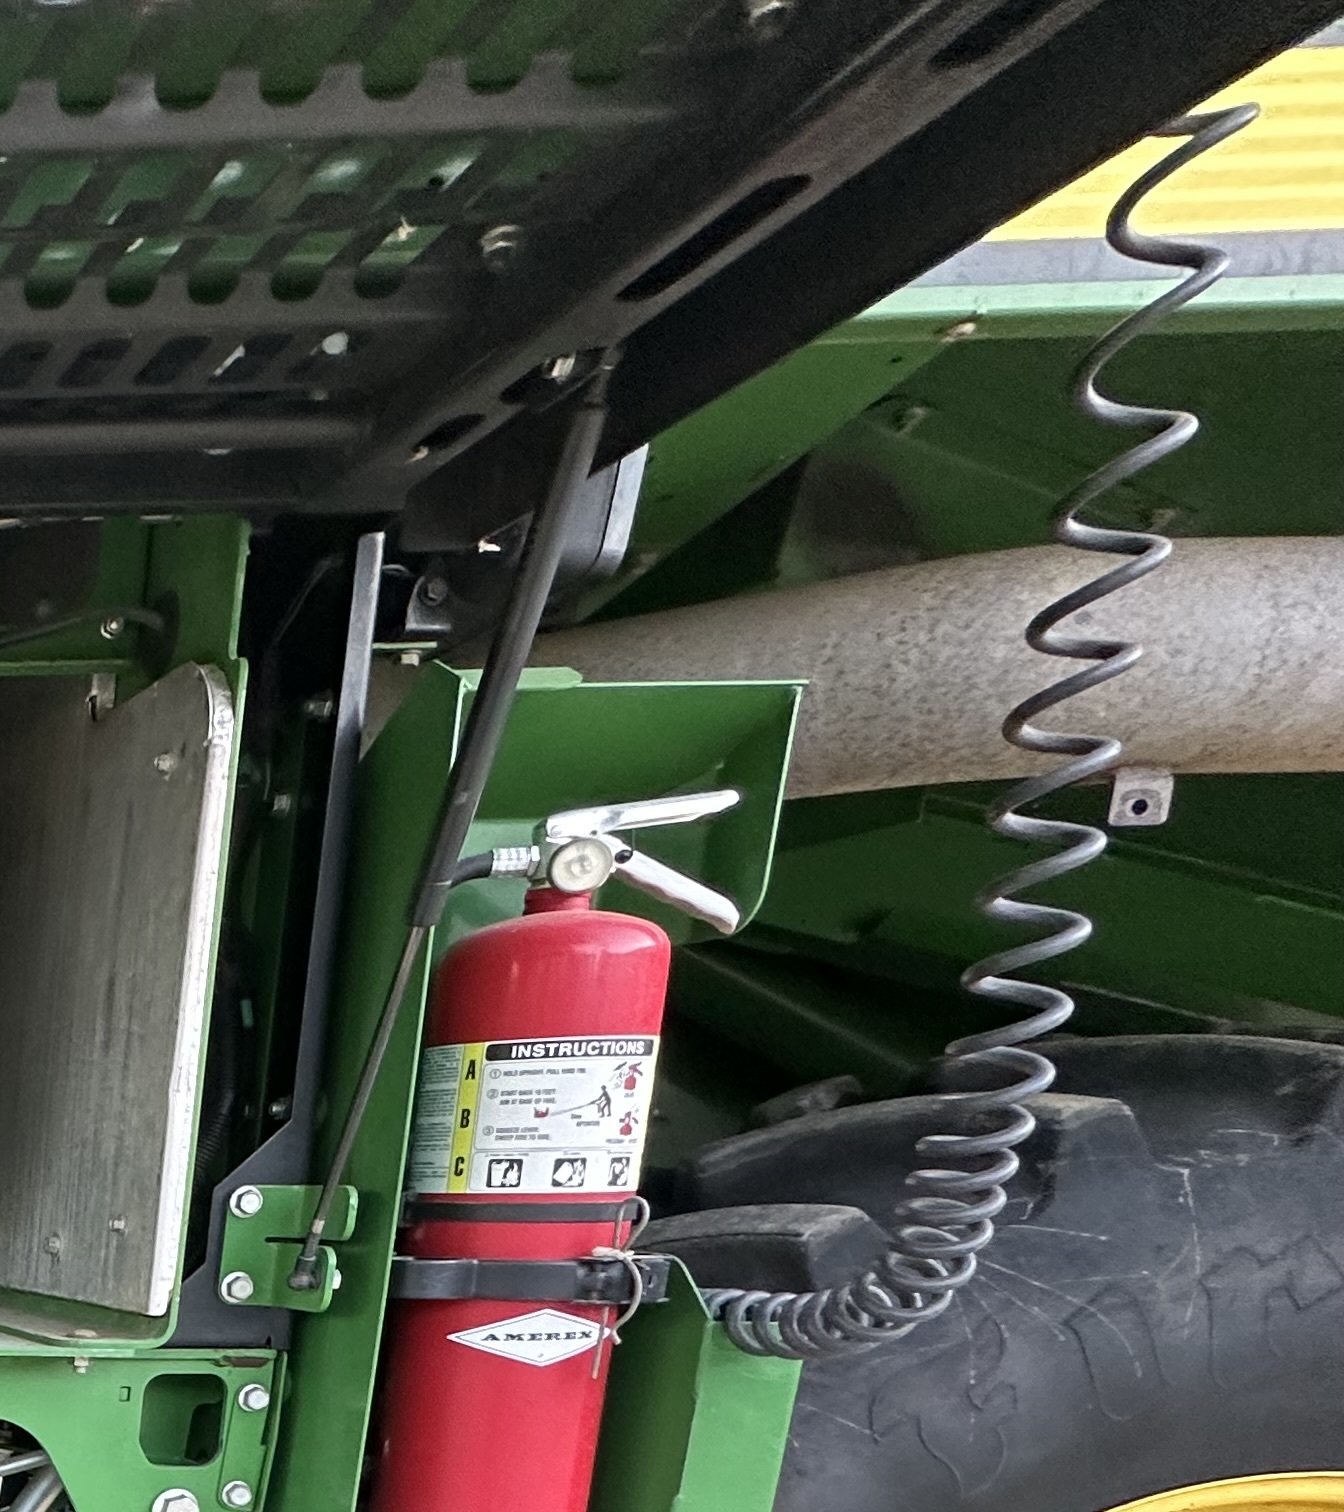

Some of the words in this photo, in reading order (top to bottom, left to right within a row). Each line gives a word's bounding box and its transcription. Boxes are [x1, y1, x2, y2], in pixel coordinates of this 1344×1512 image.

[511, 1040, 645, 1059] INSTRUCTIONS
[464, 1059, 476, 1080] A
[459, 1108, 471, 1129] B
[453, 1156, 465, 1177] C
[480, 1330, 593, 1342] AMEREX
